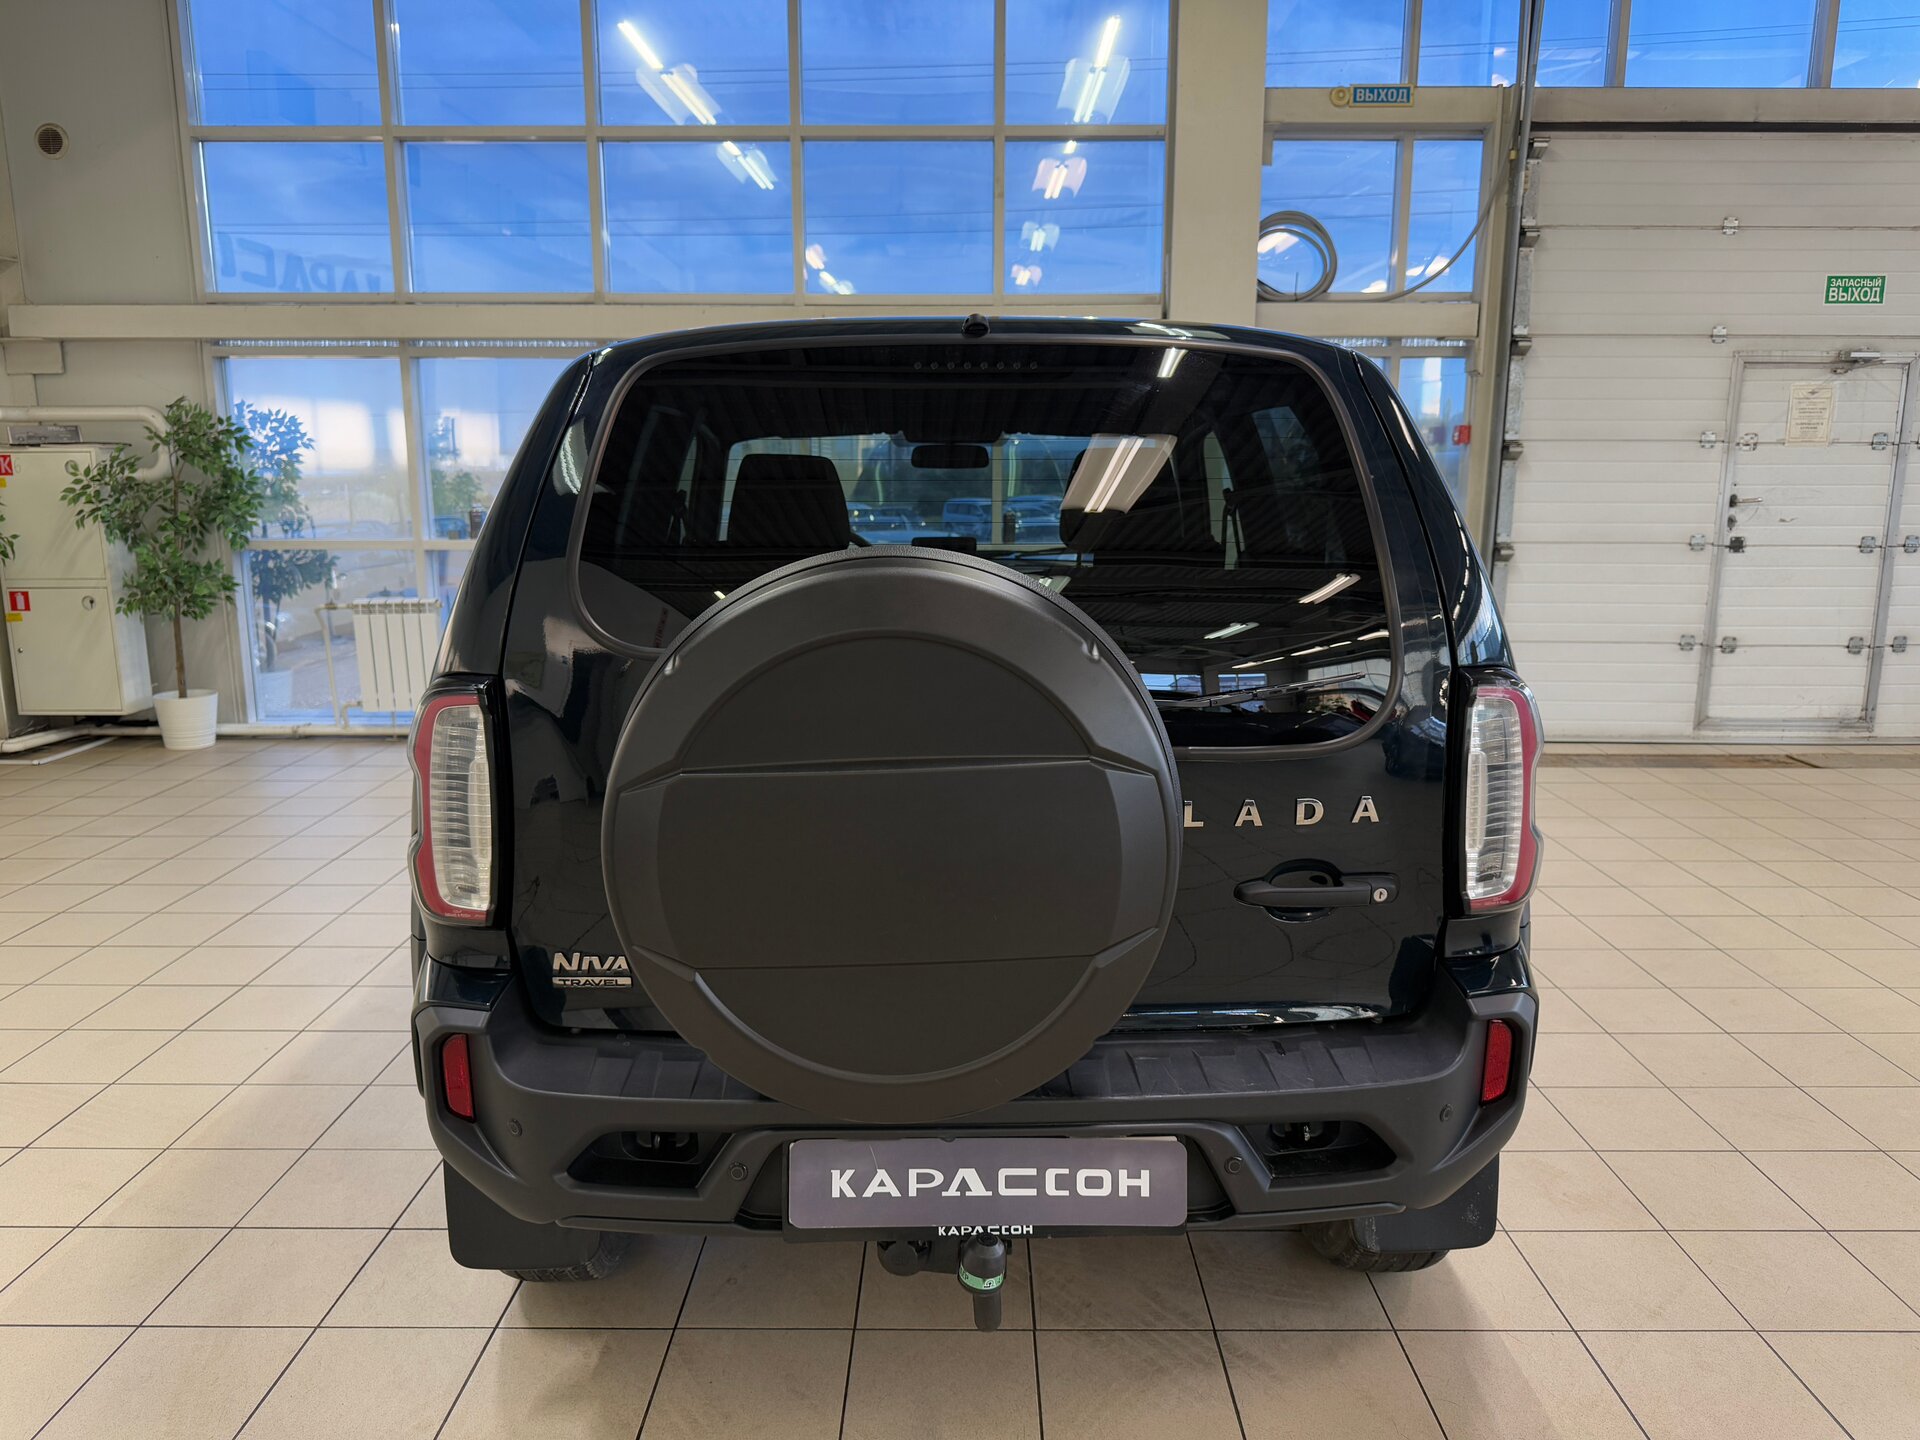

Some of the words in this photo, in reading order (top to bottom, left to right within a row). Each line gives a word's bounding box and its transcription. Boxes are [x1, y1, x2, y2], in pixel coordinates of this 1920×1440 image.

[1355, 88, 1408, 103] ВЫХОД
[1830, 277, 1882, 287] ЗАПАСНЫЙ
[1828, 287, 1880, 302] ВЫХОД
[1183, 795, 1380, 828] LADA
[558, 979, 626, 987] TRAVEL
[829, 1167, 1151, 1199] КАРАССОН
